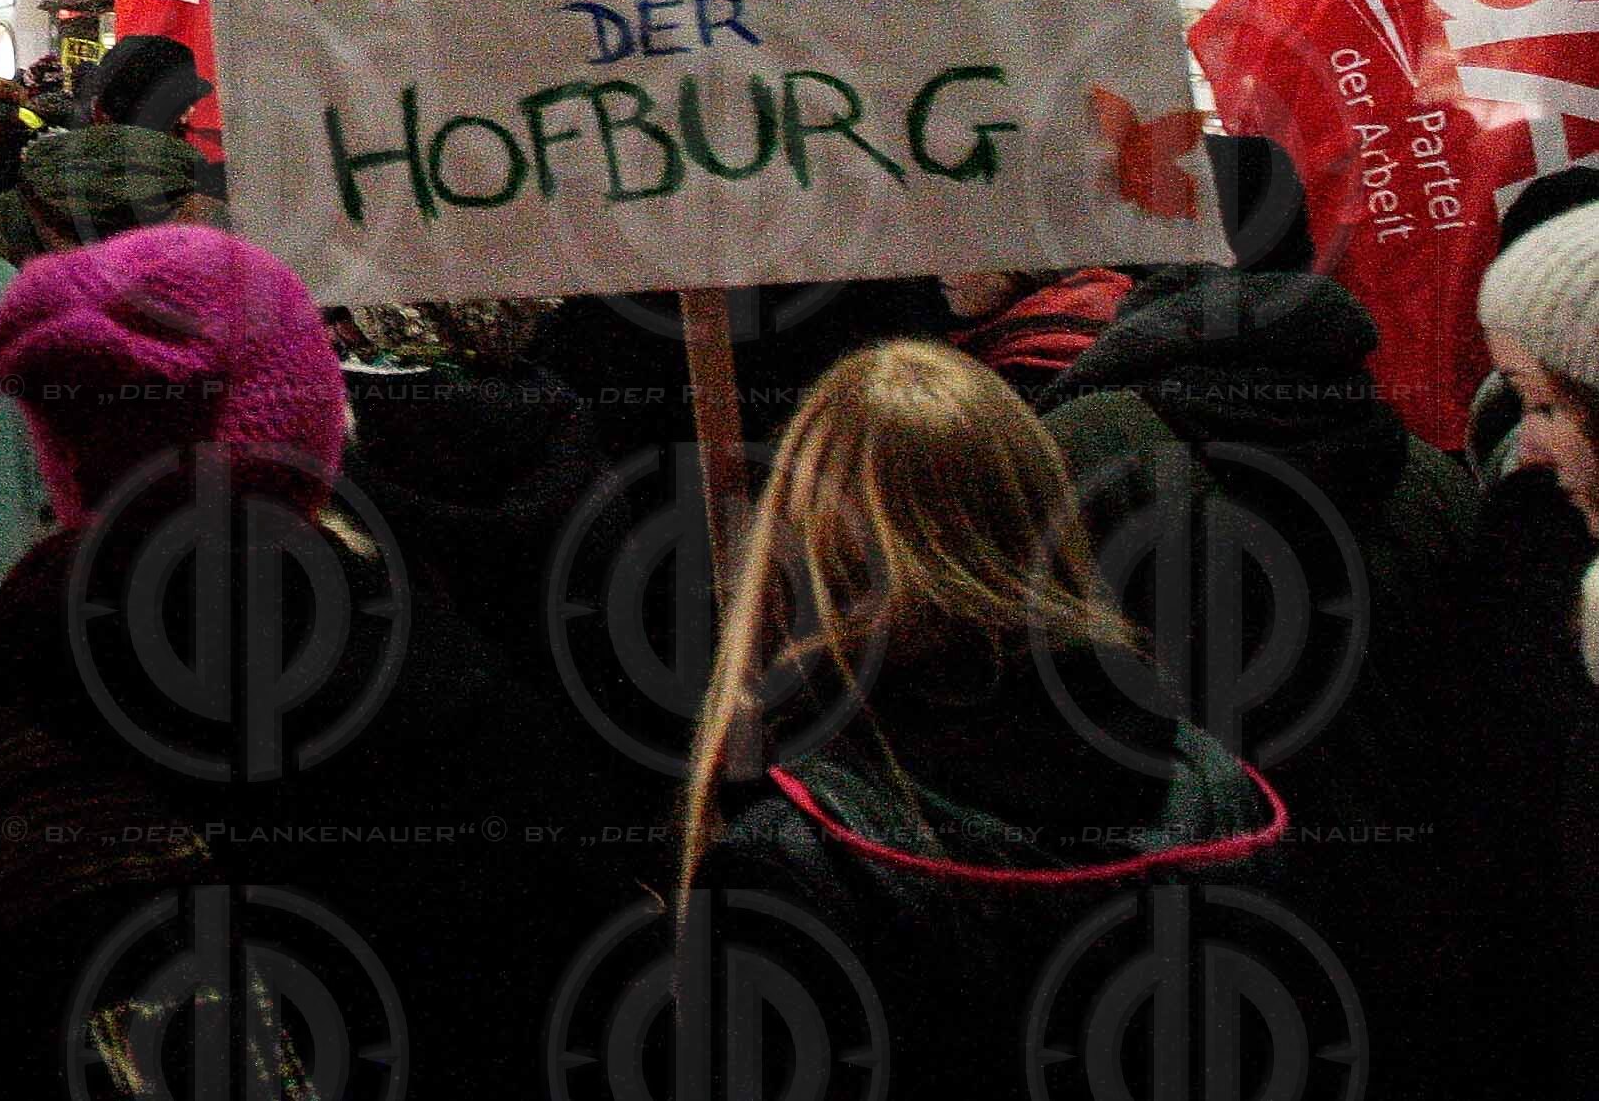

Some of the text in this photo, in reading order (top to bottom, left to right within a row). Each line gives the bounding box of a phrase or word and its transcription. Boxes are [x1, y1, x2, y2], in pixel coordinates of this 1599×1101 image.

[322, 64, 1018, 225] HOFBURG
[1331, 48, 1416, 244] der Arbeit
[1407, 110, 1477, 231] Partei
